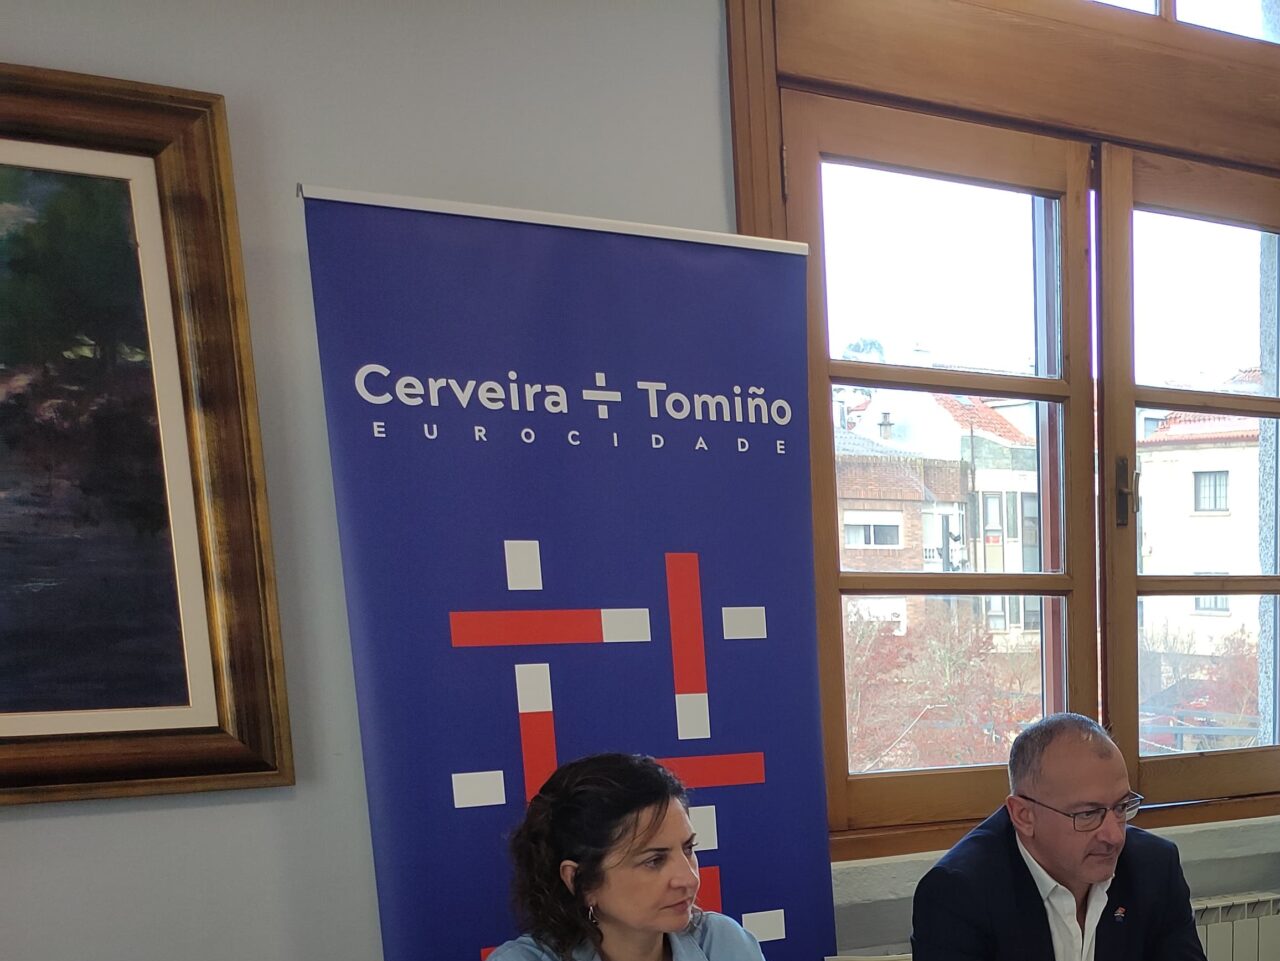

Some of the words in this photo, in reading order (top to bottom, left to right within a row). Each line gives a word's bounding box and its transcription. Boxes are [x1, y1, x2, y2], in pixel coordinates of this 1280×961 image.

[354, 363, 569, 414] Cerveira
[636, 381, 792, 426] Tomiño
[372, 421, 786, 454] EUROCIDADE
